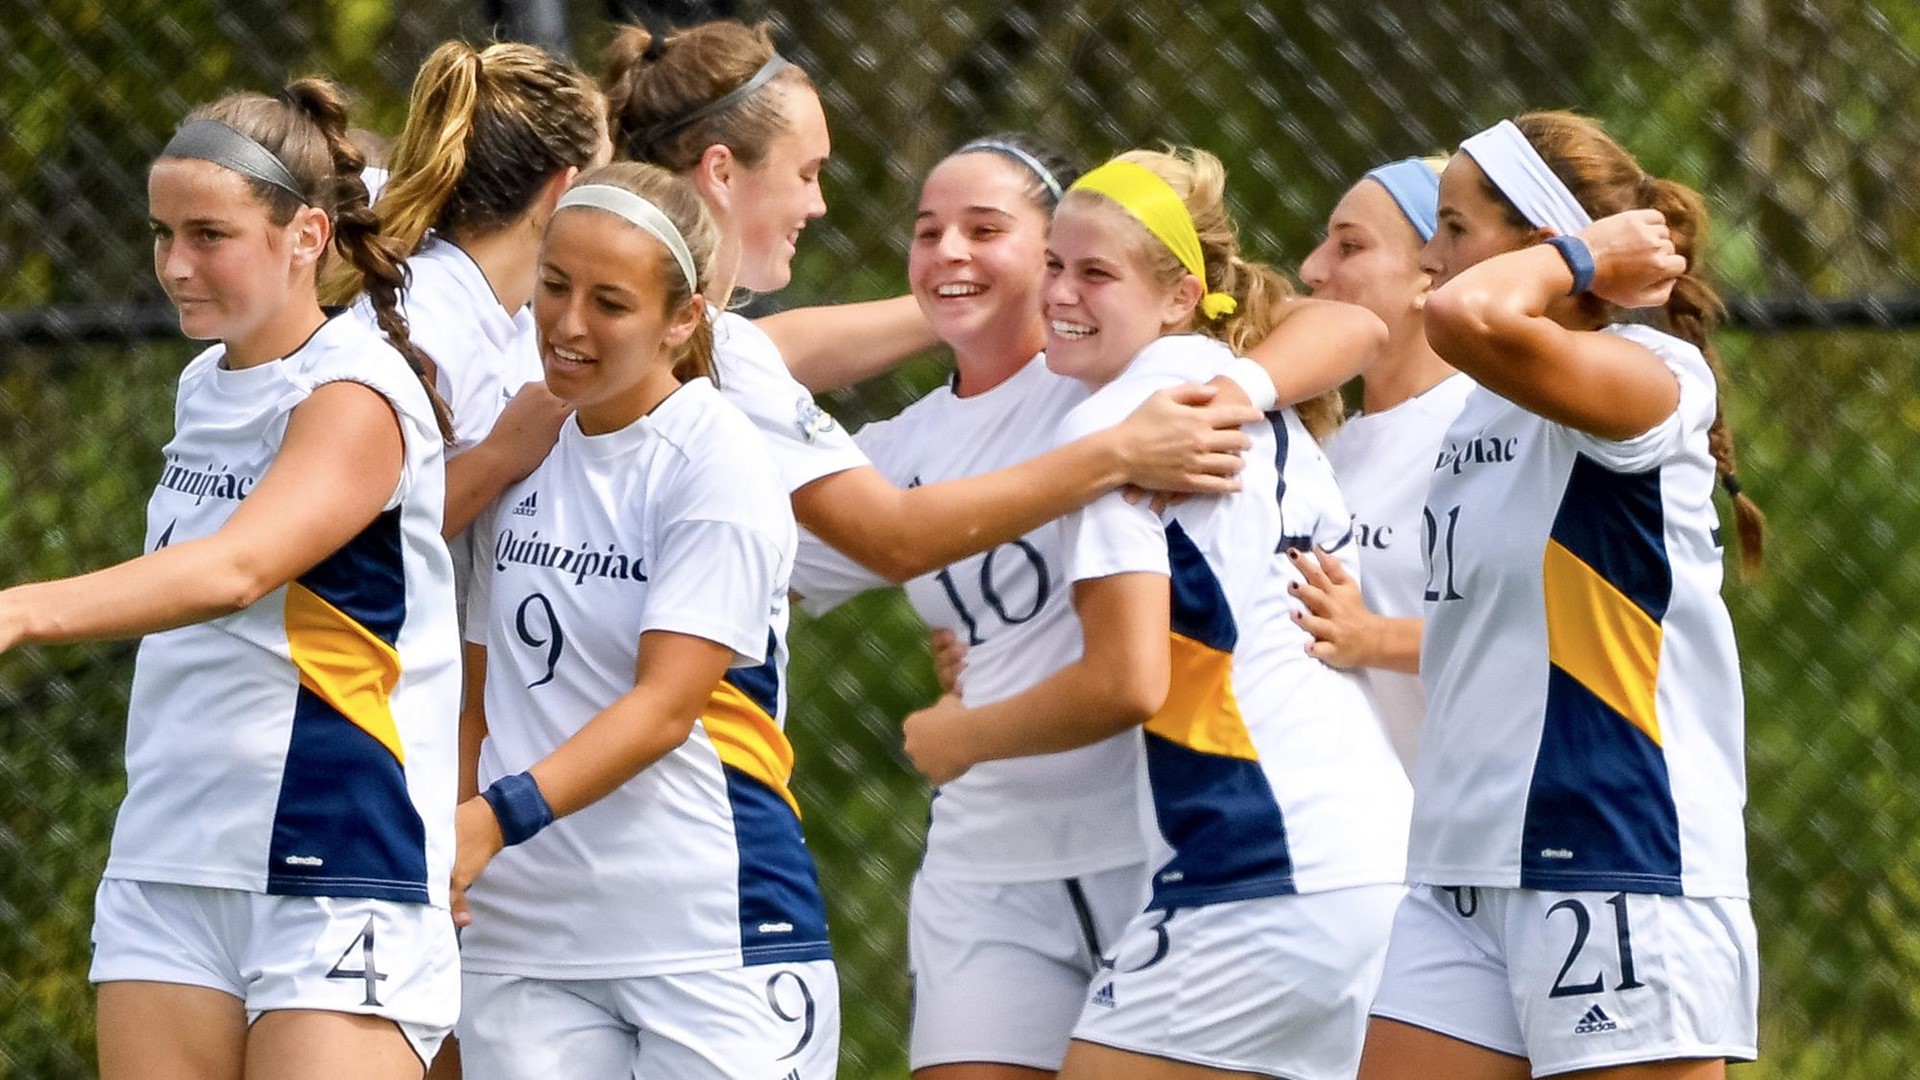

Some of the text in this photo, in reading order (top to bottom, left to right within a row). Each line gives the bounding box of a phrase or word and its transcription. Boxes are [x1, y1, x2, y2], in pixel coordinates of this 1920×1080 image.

[495, 529, 649, 586] Quinnipiac
[935, 540, 1050, 647] 10
[515, 592, 563, 689] 9
[325, 913, 389, 1008] 4
[1101, 906, 1175, 975] 3
[1545, 892, 1646, 999] 21
[766, 970, 815, 1061] 9
[1574, 1020, 1618, 1035] adidas
